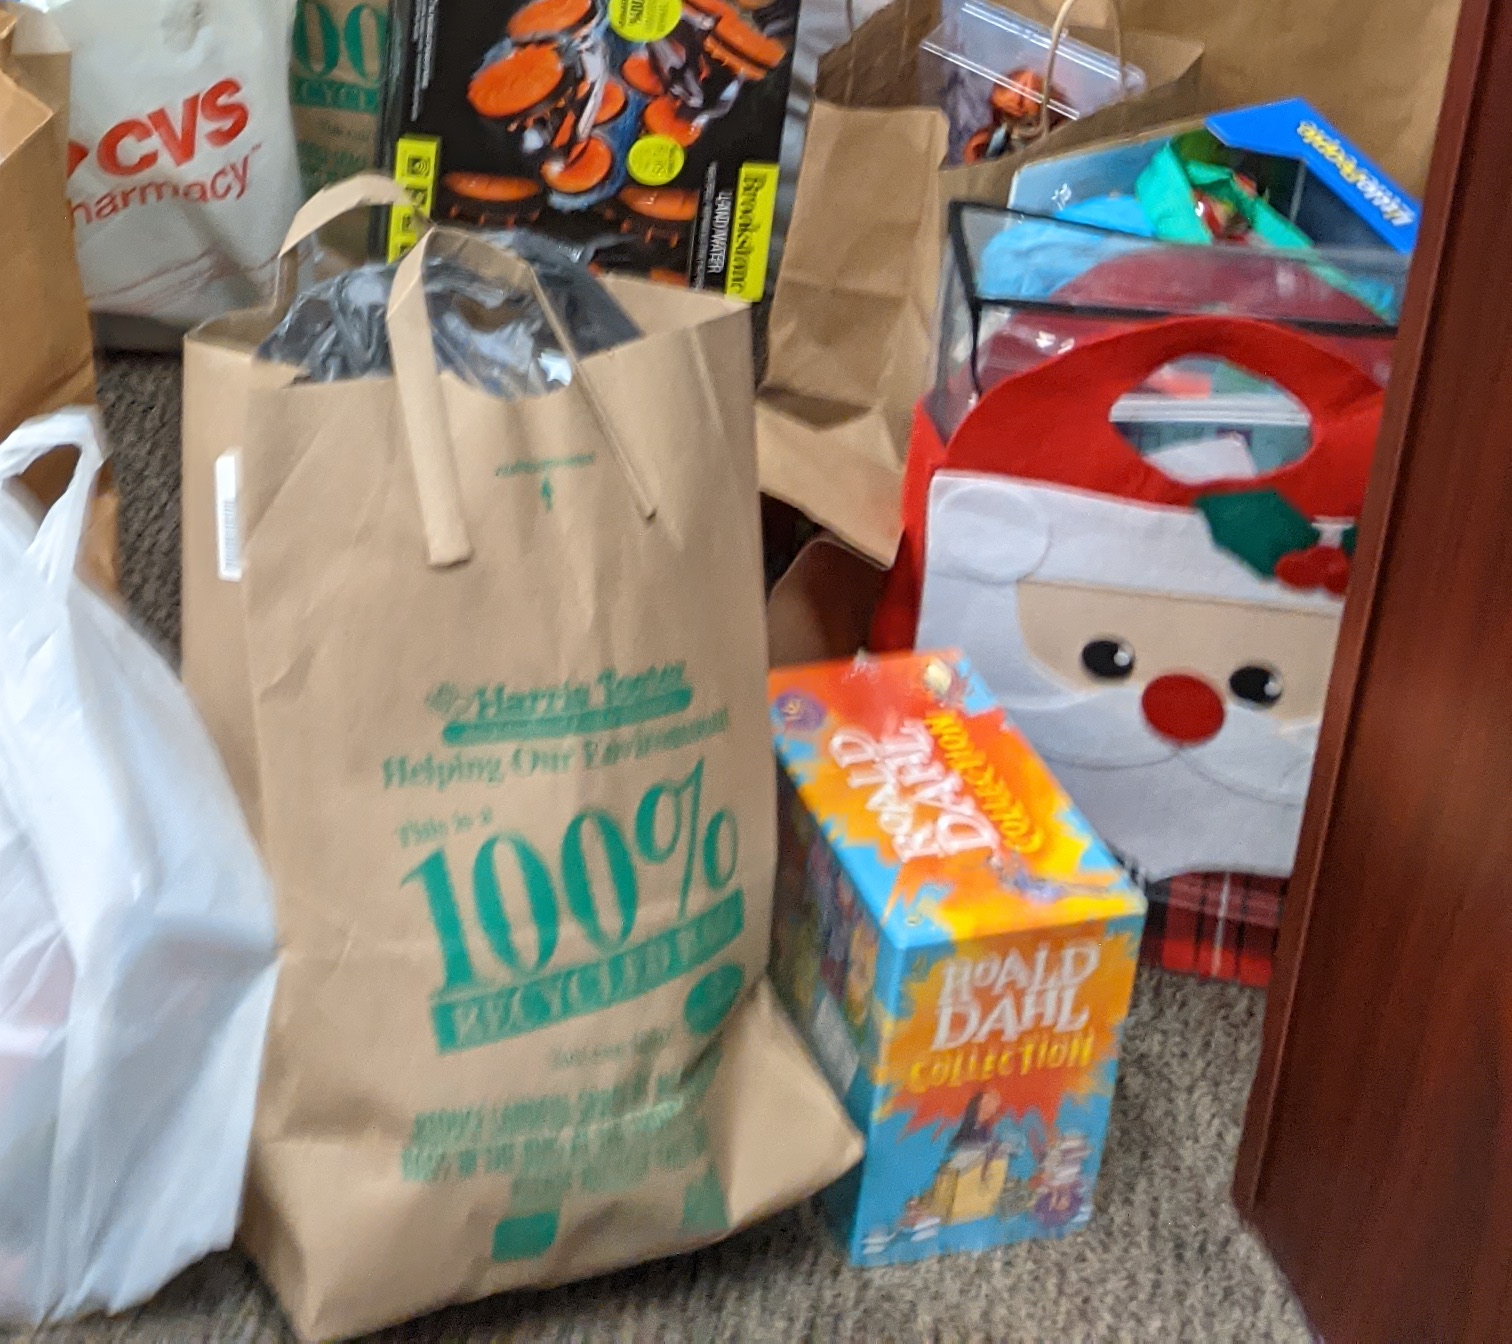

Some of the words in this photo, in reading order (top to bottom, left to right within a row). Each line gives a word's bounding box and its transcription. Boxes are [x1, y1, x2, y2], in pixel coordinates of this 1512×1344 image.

[96, 77, 249, 177] CVS
[72, 154, 250, 225] harmacy
[729, 173, 767, 295] Brookstone
[383, 752, 505, 793] Helping
[509, 747, 574, 775] Our
[829, 727, 940, 863] ROALD
[399, 755, 738, 1002] 100%
[939, 939, 1101, 1002] ROALD
[931, 986, 1091, 1051] DAHL
[909, 1030, 1096, 1093] COLLECTION
